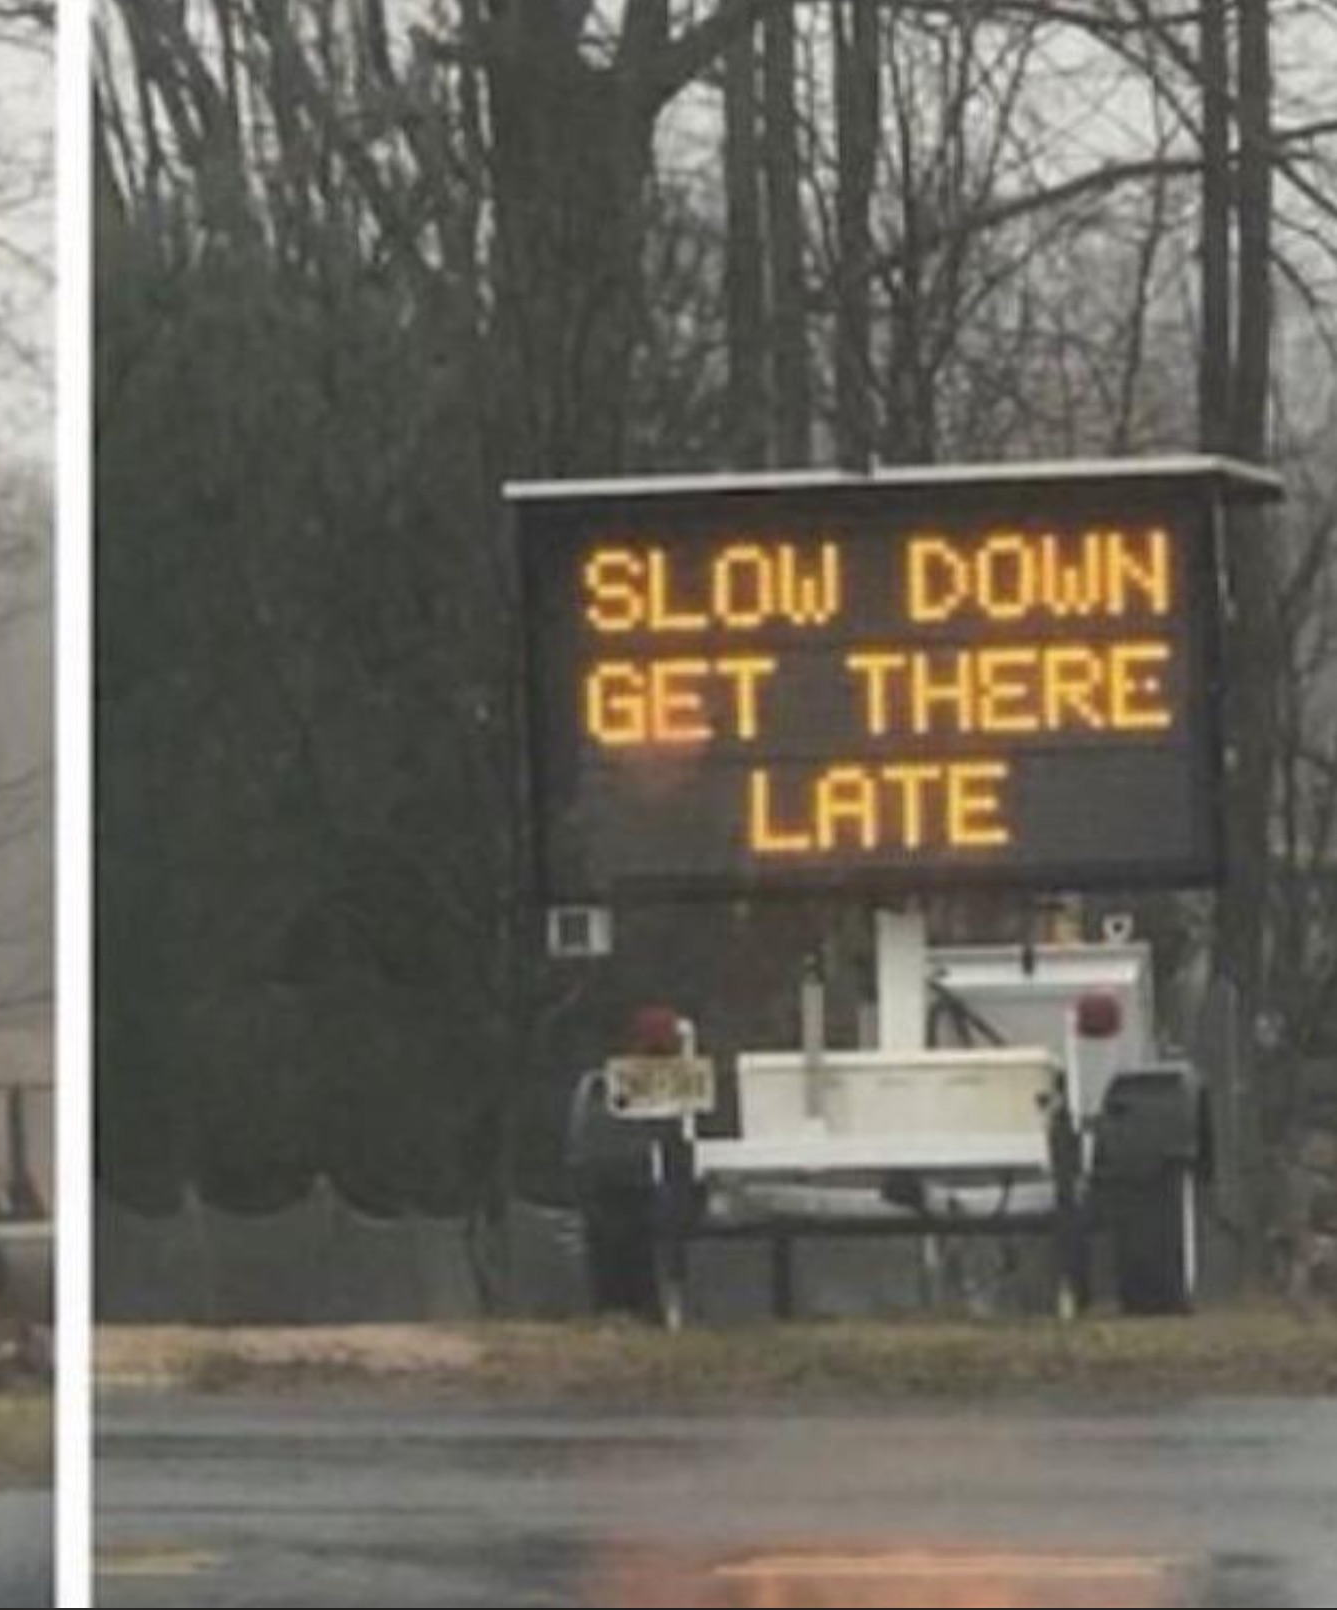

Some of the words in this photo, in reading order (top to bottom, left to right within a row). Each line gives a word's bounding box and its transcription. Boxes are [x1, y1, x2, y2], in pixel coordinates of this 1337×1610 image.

[585, 543, 840, 632] SLOW
[909, 531, 1168, 622] DOWN
[586, 656, 776, 746] GET
[846, 642, 1171, 734] THERE
[749, 761, 1010, 852] LATE
